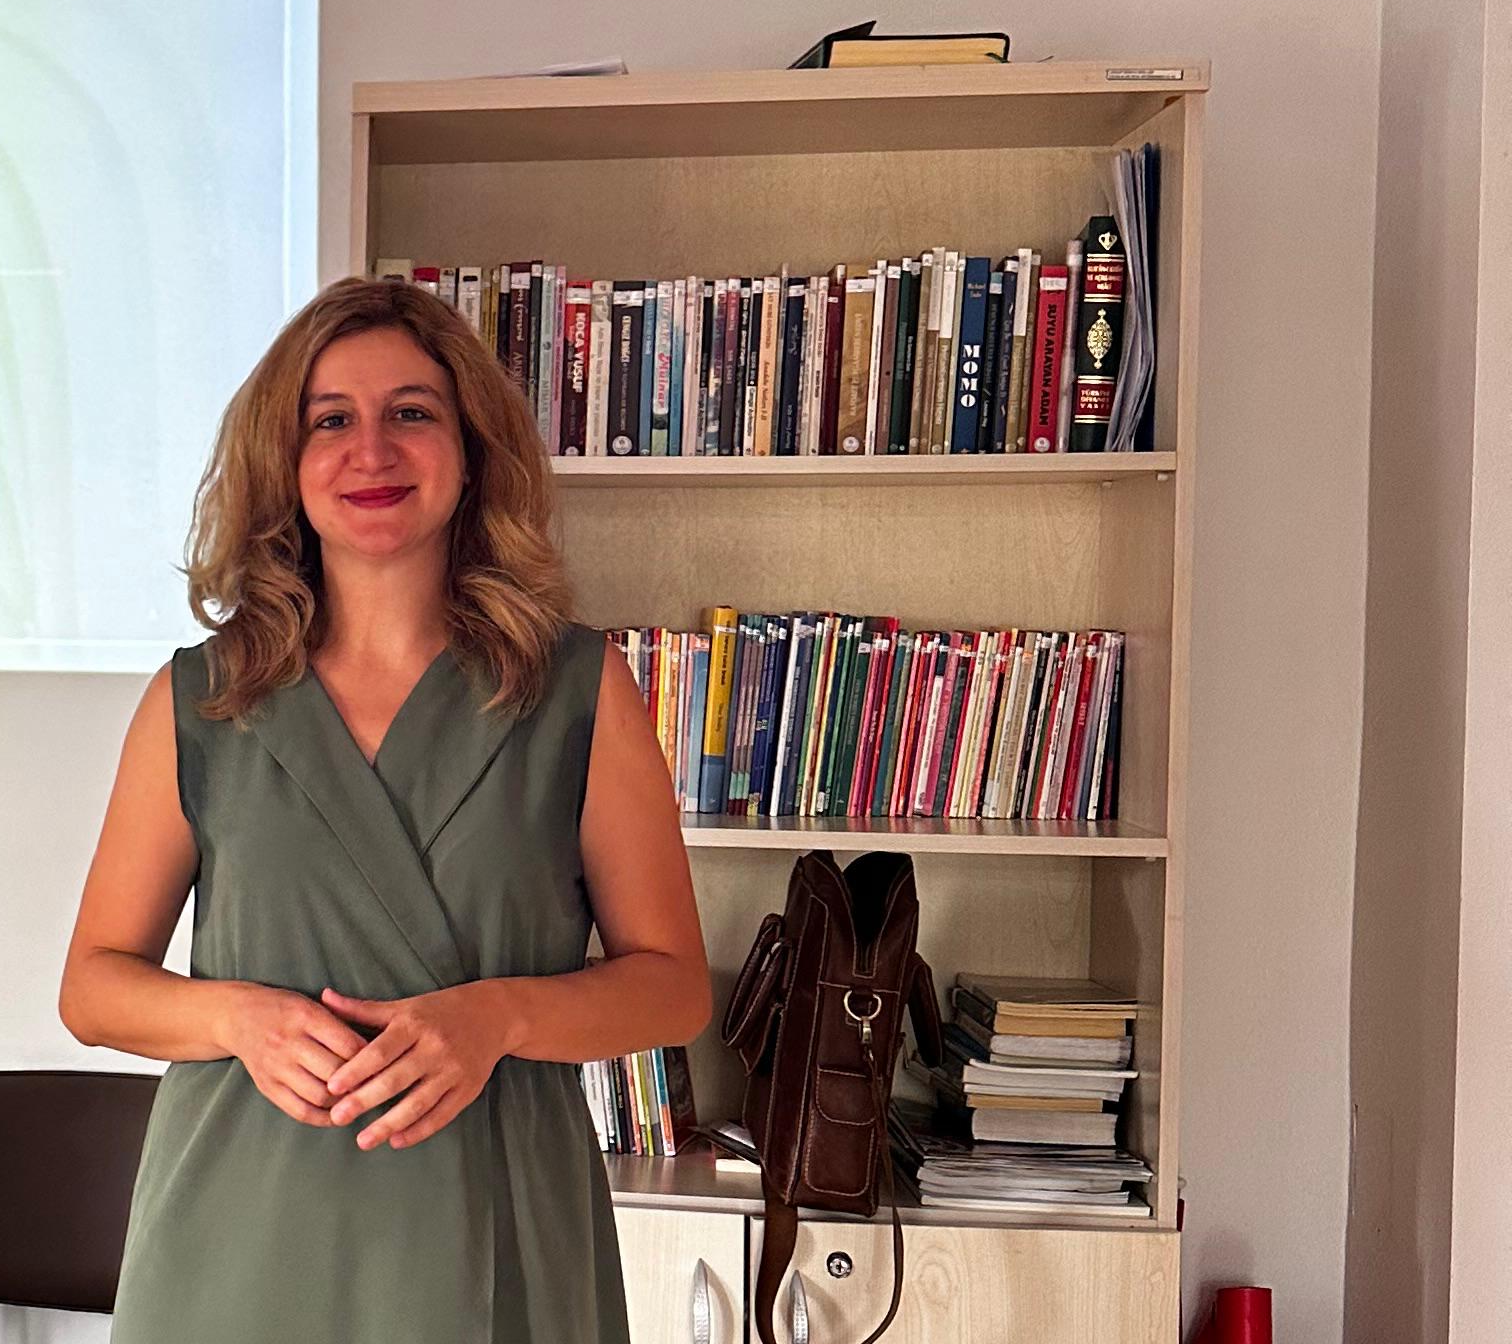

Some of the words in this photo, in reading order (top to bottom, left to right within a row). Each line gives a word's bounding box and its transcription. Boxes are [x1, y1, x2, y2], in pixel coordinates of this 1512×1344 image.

[575, 312, 588, 348] KOCA
[1045, 304, 1058, 337] SUYU
[572, 350, 585, 394] YUSUF
[960, 344, 981, 408] MOMO
[1042, 338, 1055, 388] ARAYAN
[1039, 389, 1051, 426] ADAM
